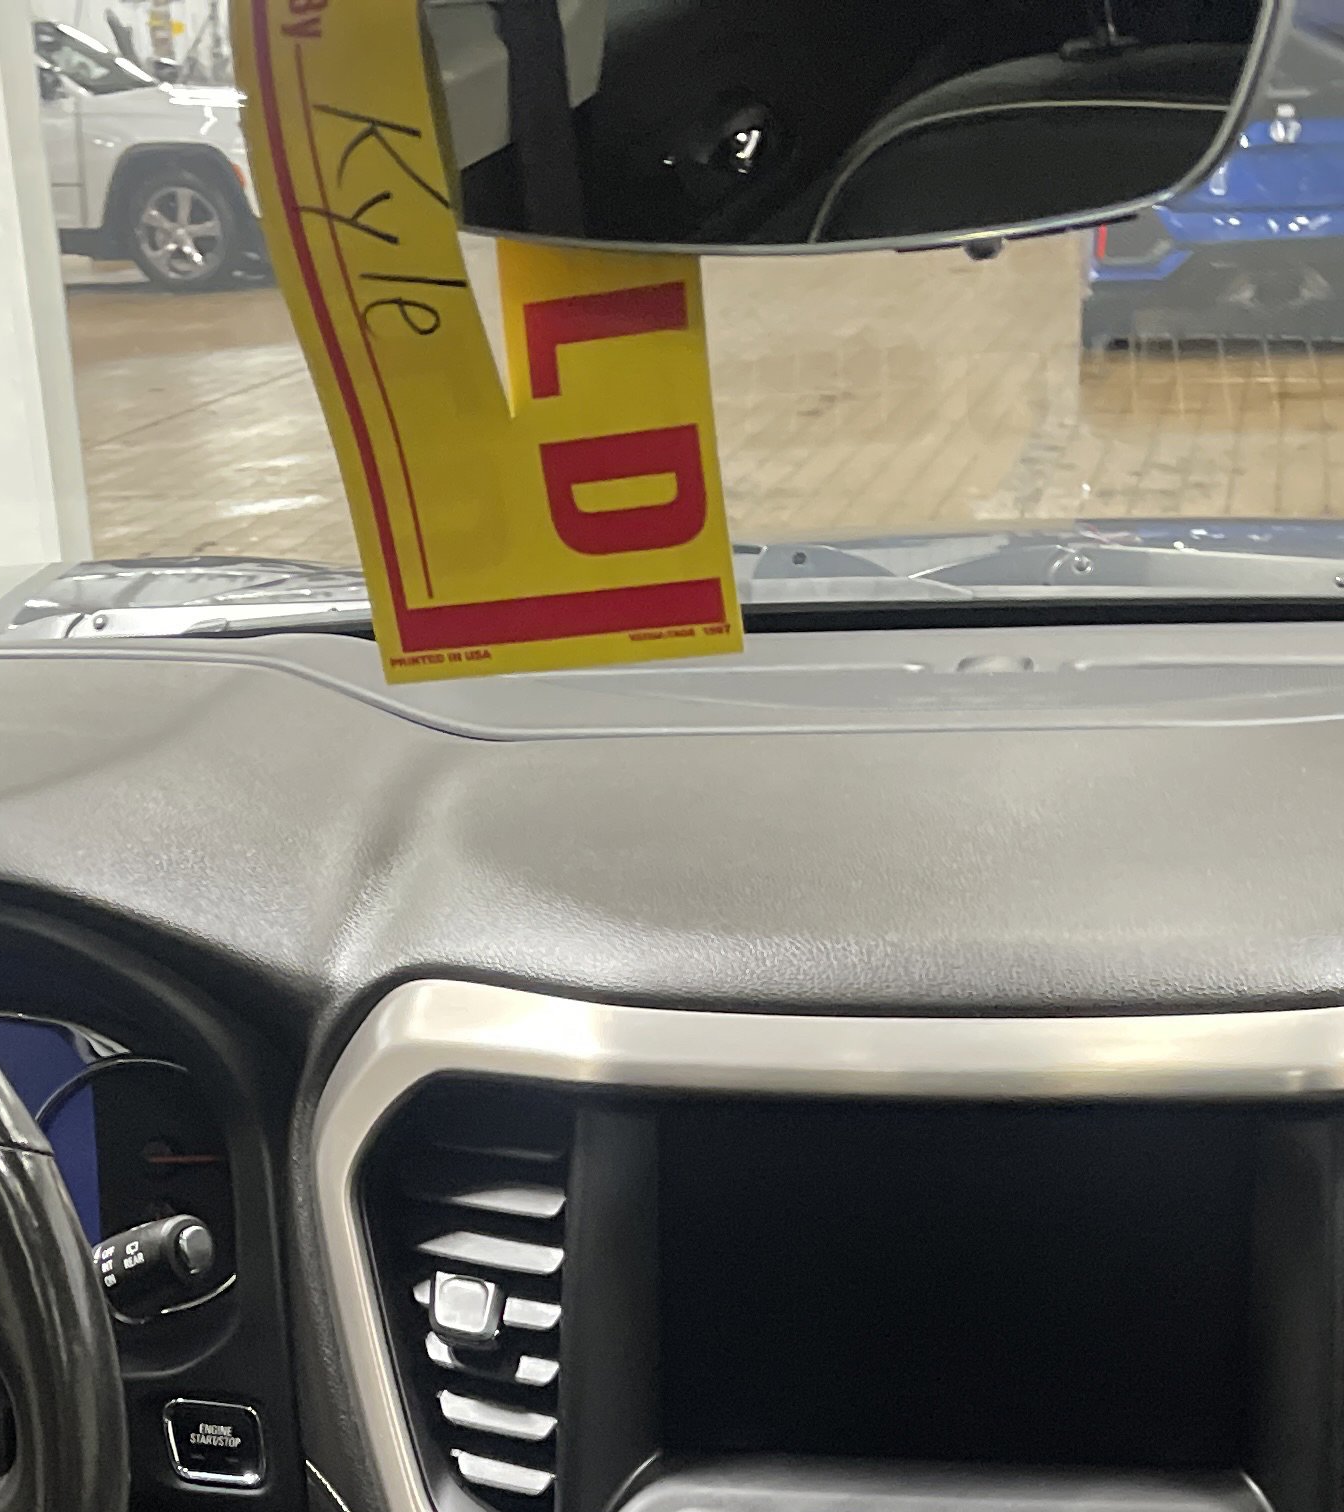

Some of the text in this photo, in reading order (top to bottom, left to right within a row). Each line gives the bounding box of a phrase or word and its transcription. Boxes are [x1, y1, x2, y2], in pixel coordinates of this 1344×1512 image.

[296, 103, 467, 338] Kyle
[389, 650, 491, 667] PRINTED IN USA
[199, 1422, 233, 1437] ENGINE
